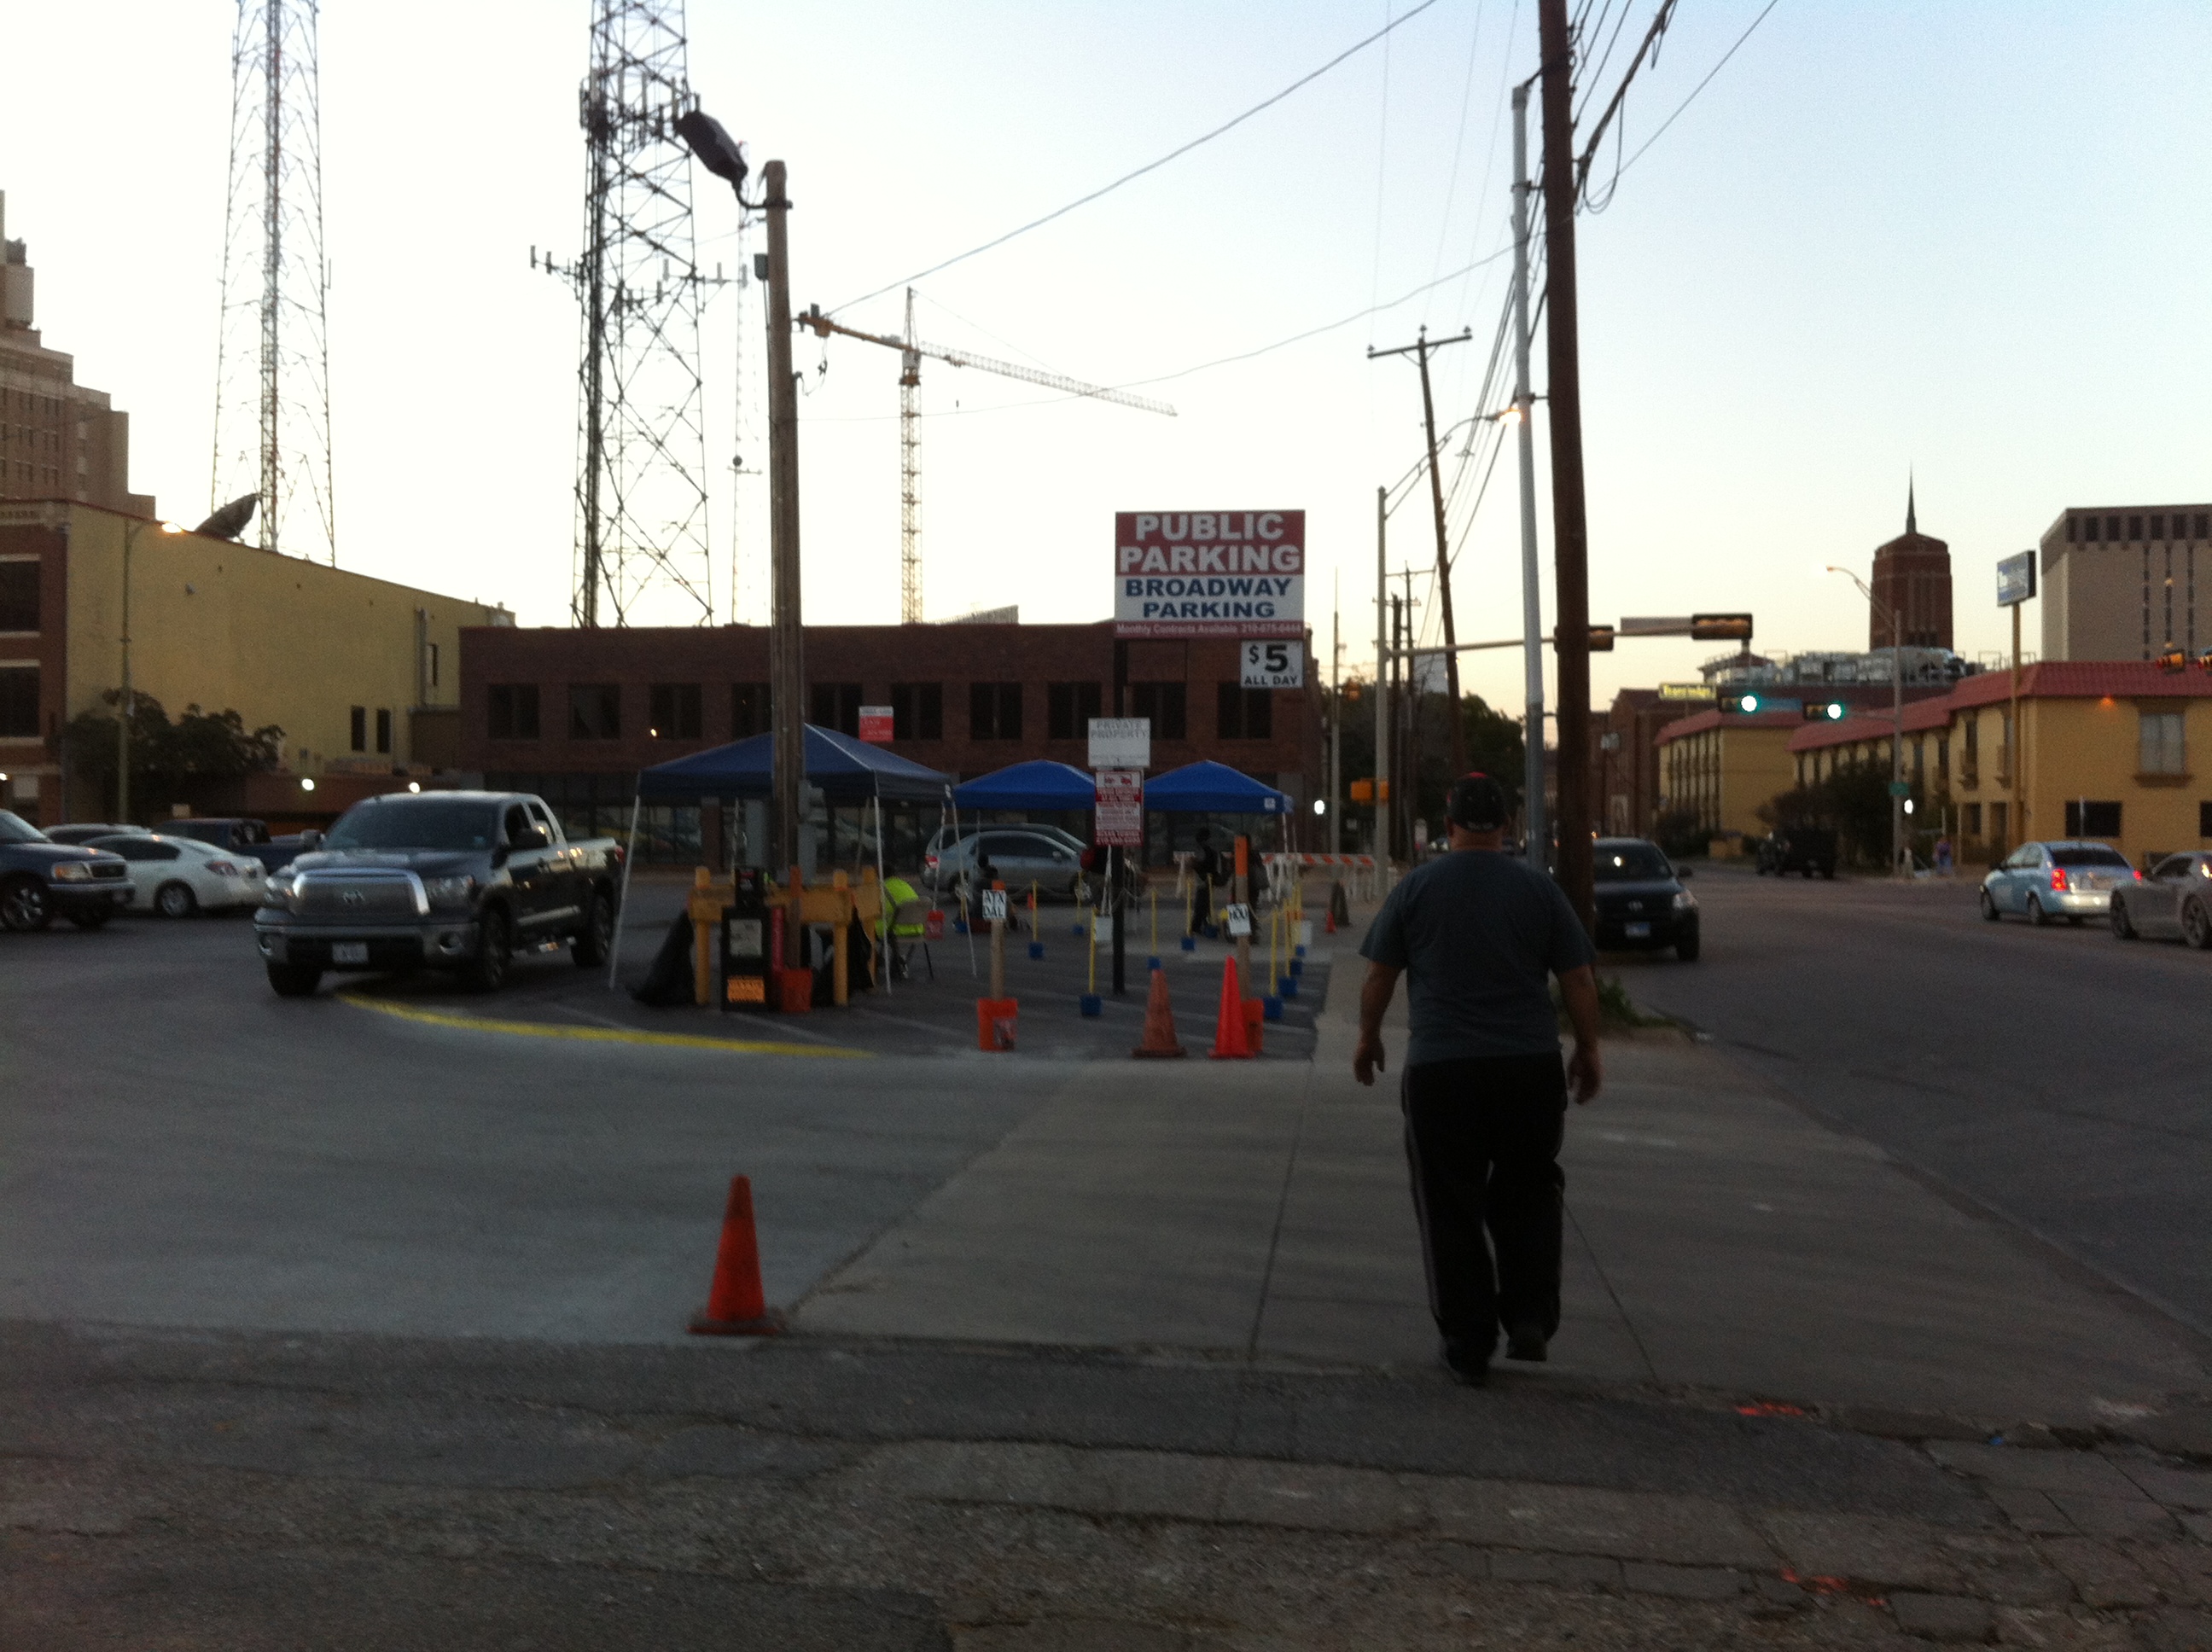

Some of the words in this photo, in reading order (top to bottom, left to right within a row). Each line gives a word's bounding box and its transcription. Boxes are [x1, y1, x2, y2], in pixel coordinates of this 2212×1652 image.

[1136, 512, 1284, 541] PUBLIC
[1120, 544, 1301, 573] PARKING
[1126, 578, 1292, 597] BROADWAY
[1144, 602, 1275, 619] PARKING
[1244, 675, 1266, 686] ALL
[1272, 675, 1298, 686] DAY
